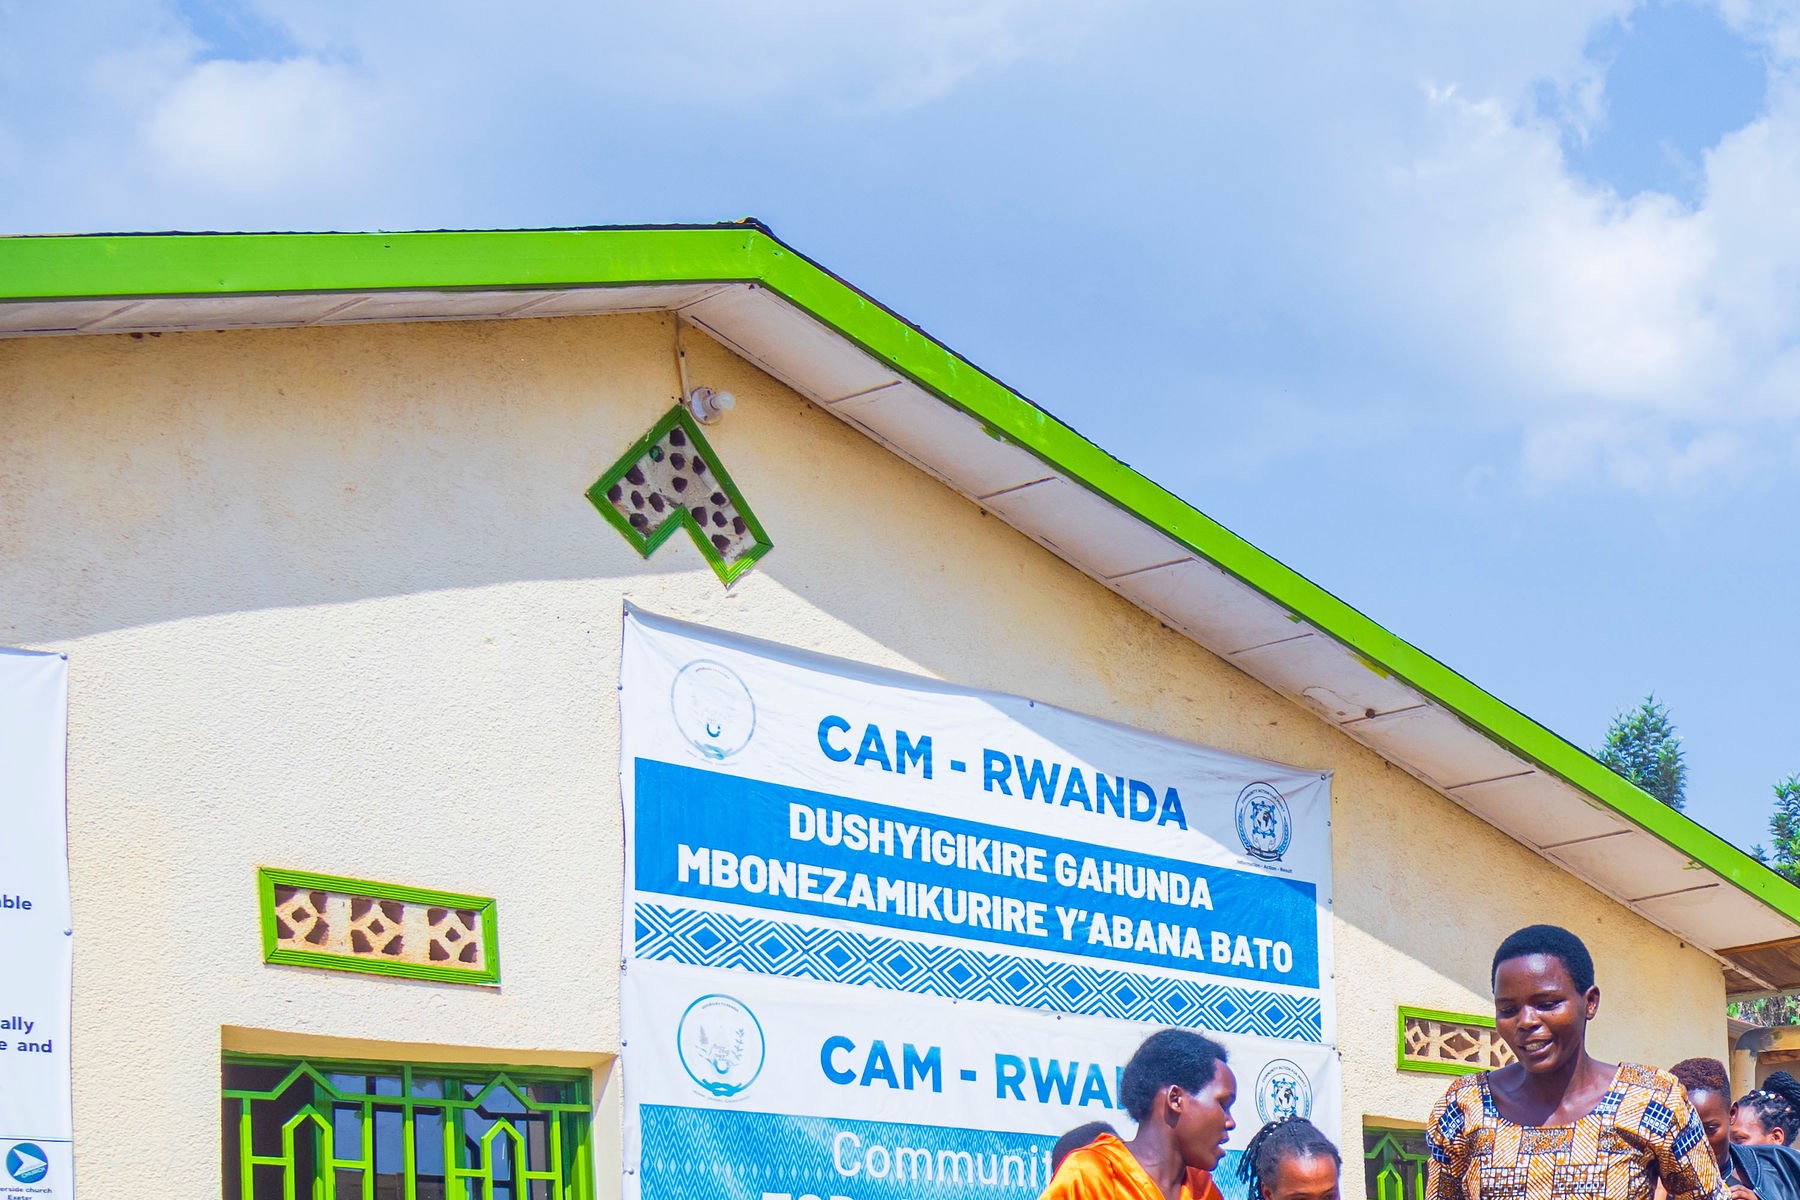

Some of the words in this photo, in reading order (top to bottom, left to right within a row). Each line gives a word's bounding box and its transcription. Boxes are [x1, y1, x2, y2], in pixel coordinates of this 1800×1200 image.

[818, 715, 933, 780] CAM
[983, 748, 1189, 831] RWANDA
[789, 803, 1048, 883] DUSHYIGIKIRE
[1054, 852, 1214, 911] GAHUNDA
[0, 894, 33, 911] ble
[678, 844, 1048, 937] MBONEZAMIKURIRE
[1211, 932, 1294, 973] BATO
[17, 1039, 53, 1054] and
[820, 1035, 943, 1094] CAM
